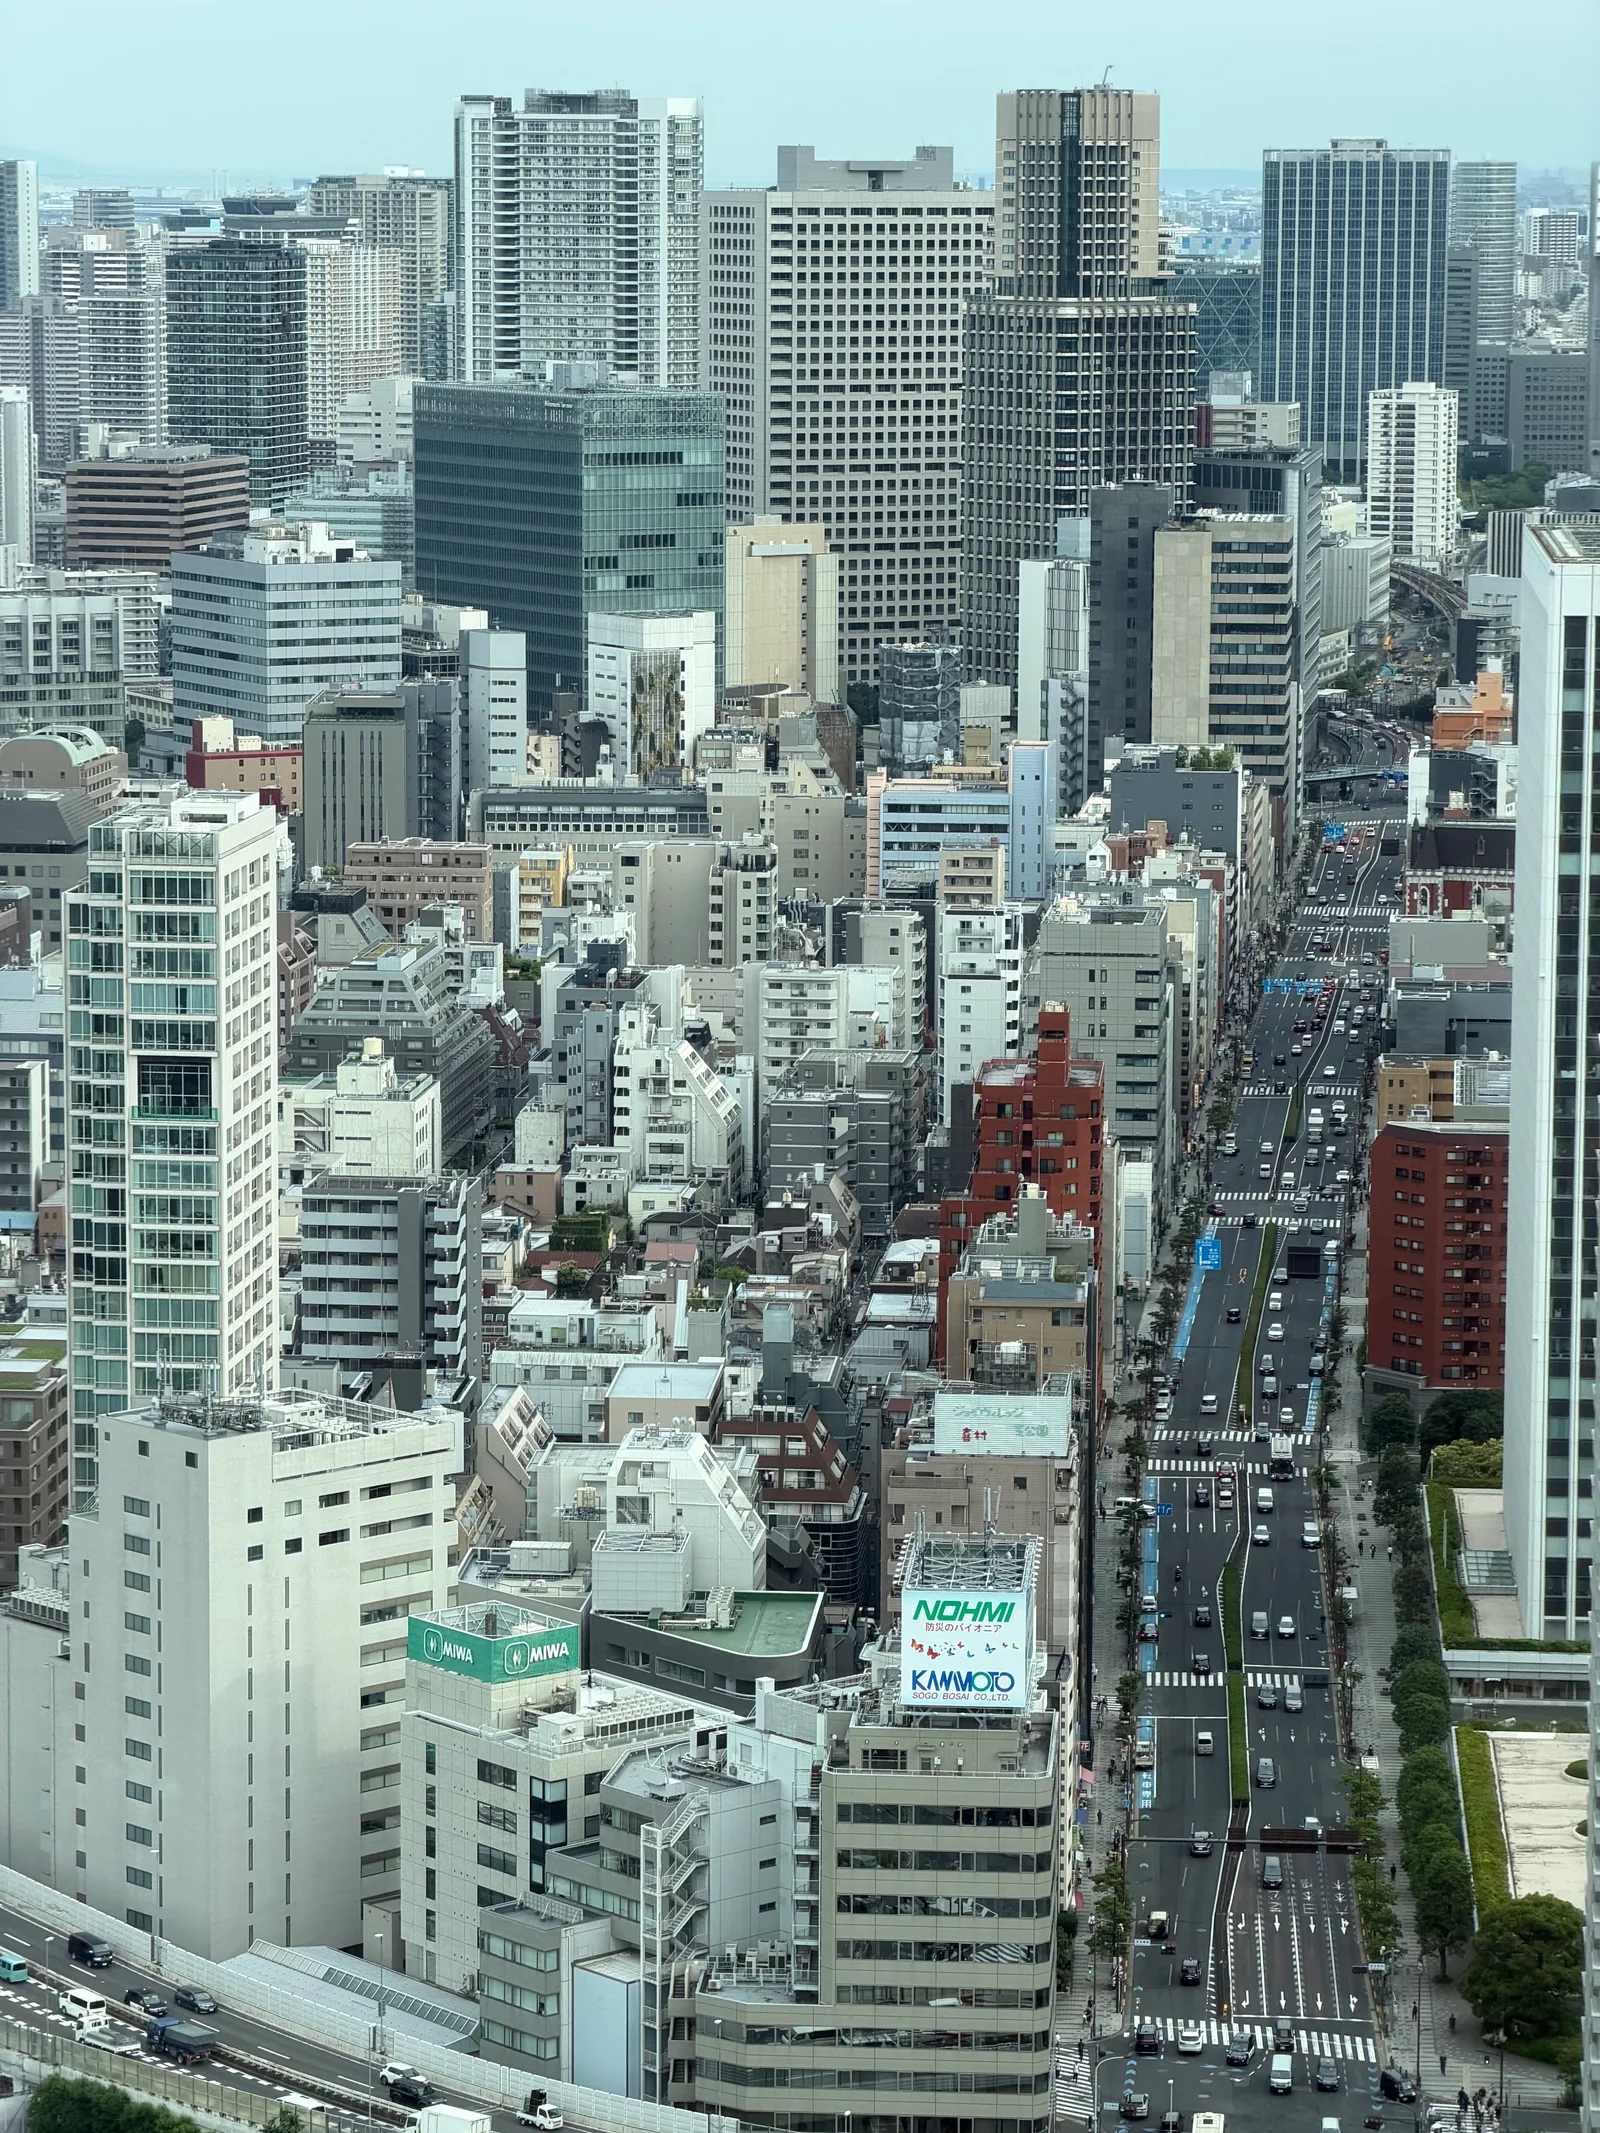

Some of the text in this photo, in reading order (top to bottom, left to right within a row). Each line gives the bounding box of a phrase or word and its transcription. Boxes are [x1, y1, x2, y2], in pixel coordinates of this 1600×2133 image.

[913, 1600, 1016, 1623] NOHMI
[925, 1622, 1002, 1633] 防災のパイオニア
[443, 1642, 473, 1663] MIWA
[530, 1642, 569, 1662] MIWA
[912, 1691, 1011, 1702] SOGO BOSAI CO.,LTD.
